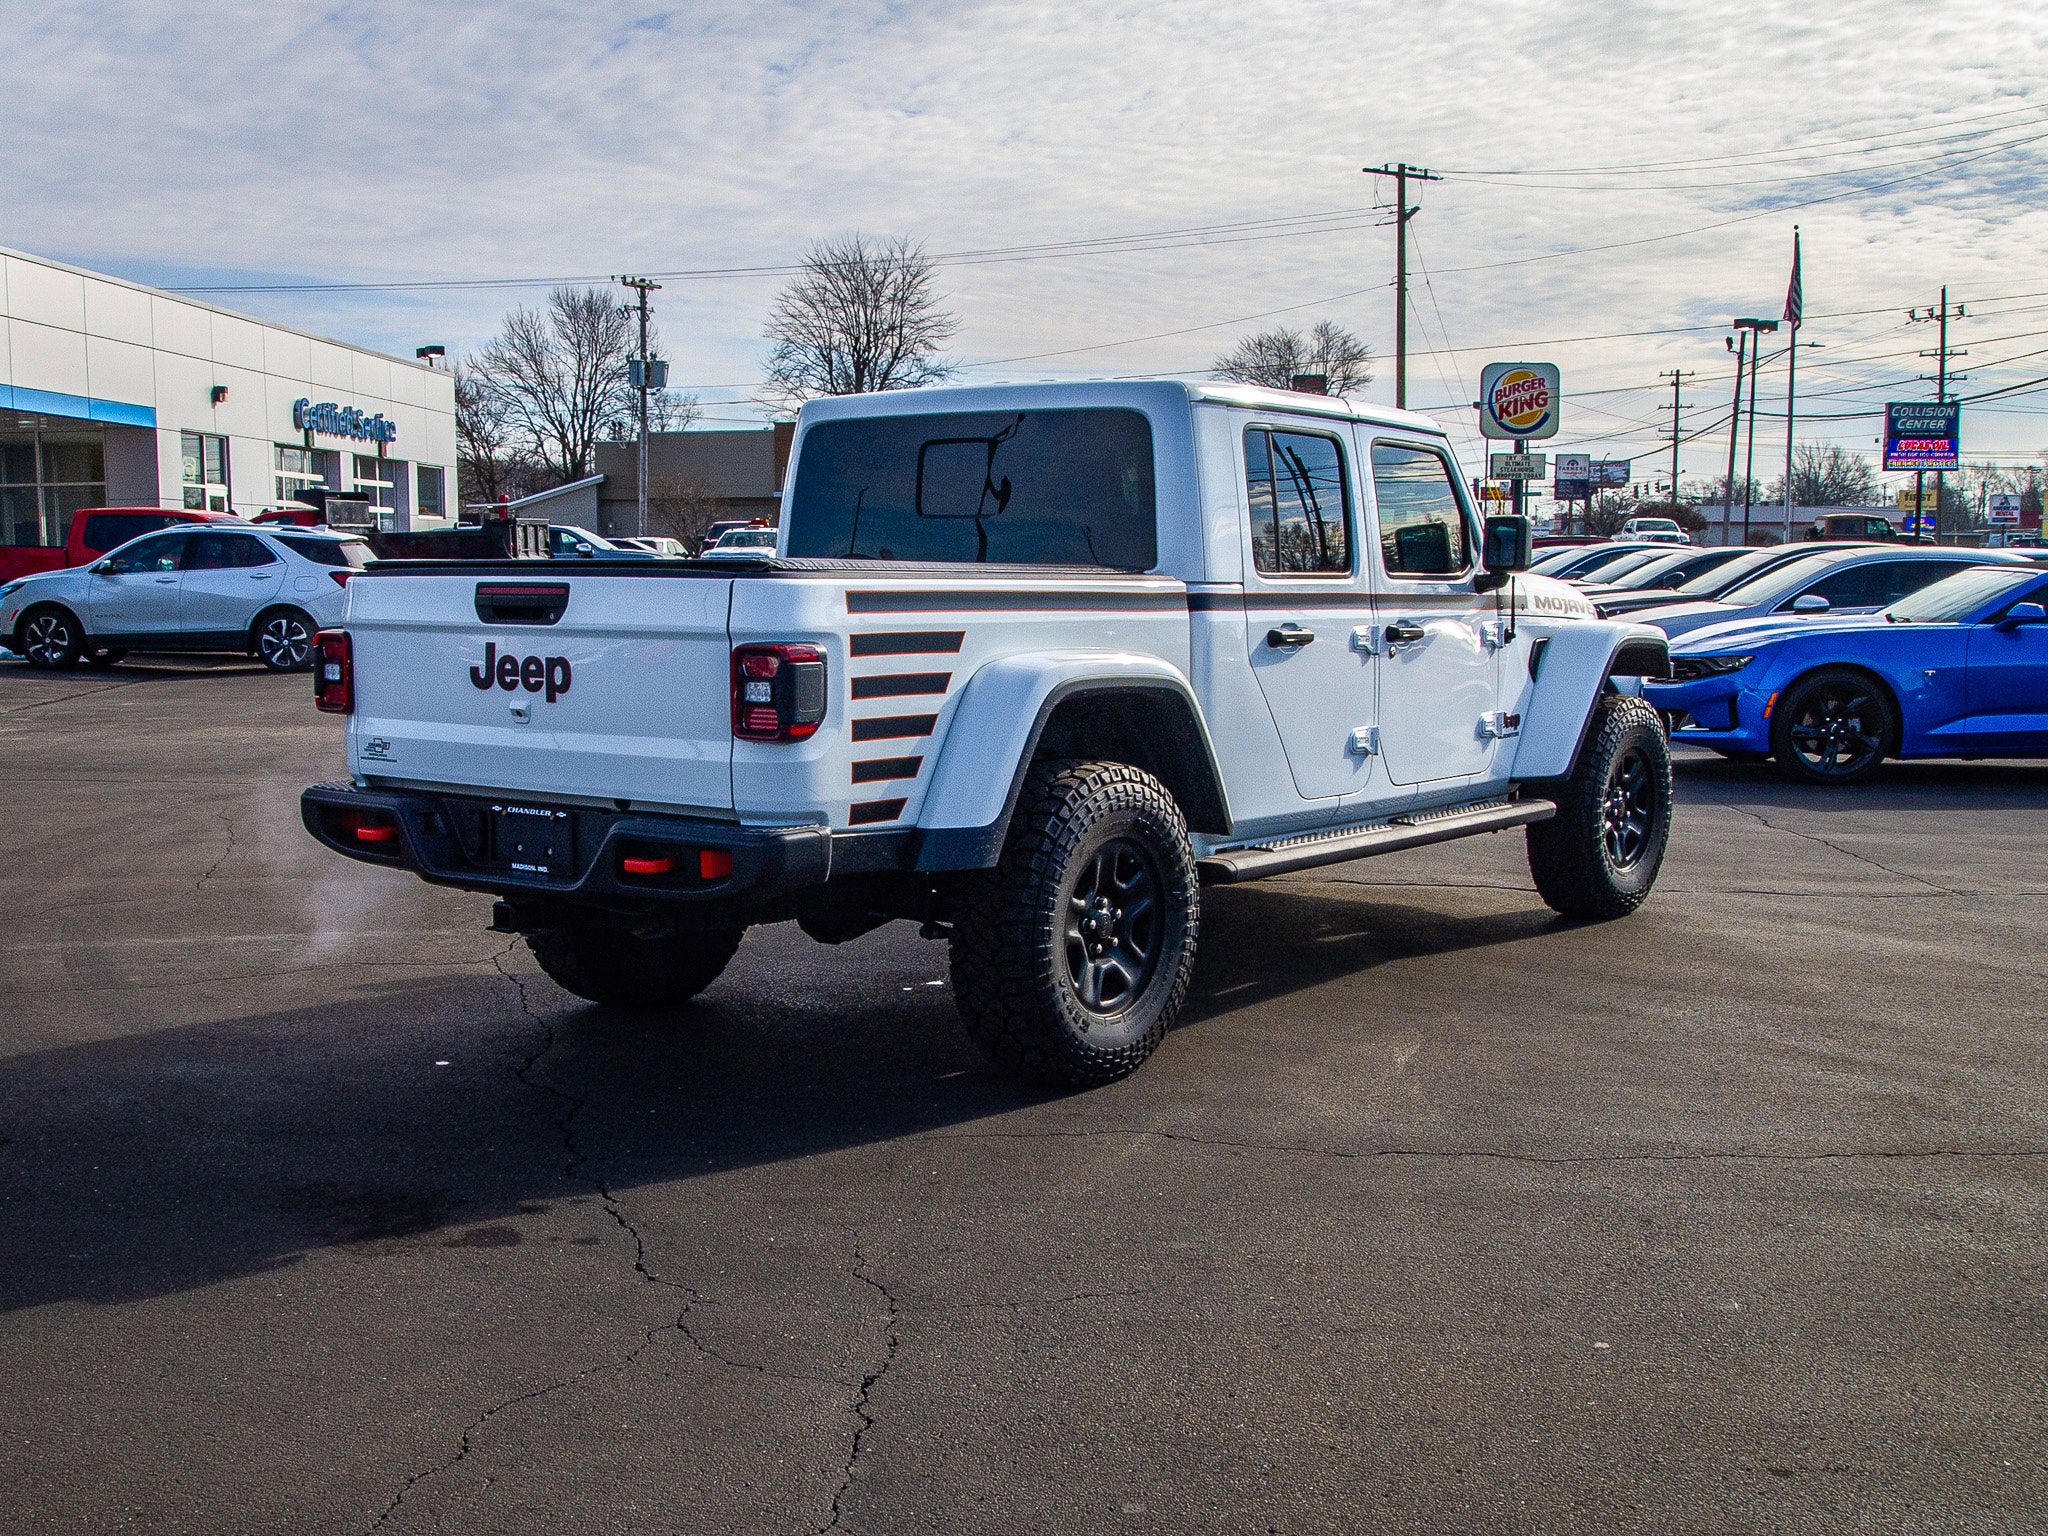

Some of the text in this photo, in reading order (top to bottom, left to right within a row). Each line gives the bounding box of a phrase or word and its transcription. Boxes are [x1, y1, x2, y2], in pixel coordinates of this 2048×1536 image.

[1495, 378, 1546, 402] BURGER
[1499, 391, 1548, 420] KING
[293, 398, 397, 442] Certified Service
[1897, 439, 1950, 451] LUCAS OIL
[1534, 595, 1595, 615] MOJAVE
[470, 642, 572, 703] Jeep
[507, 806, 552, 817] CHANDLER
